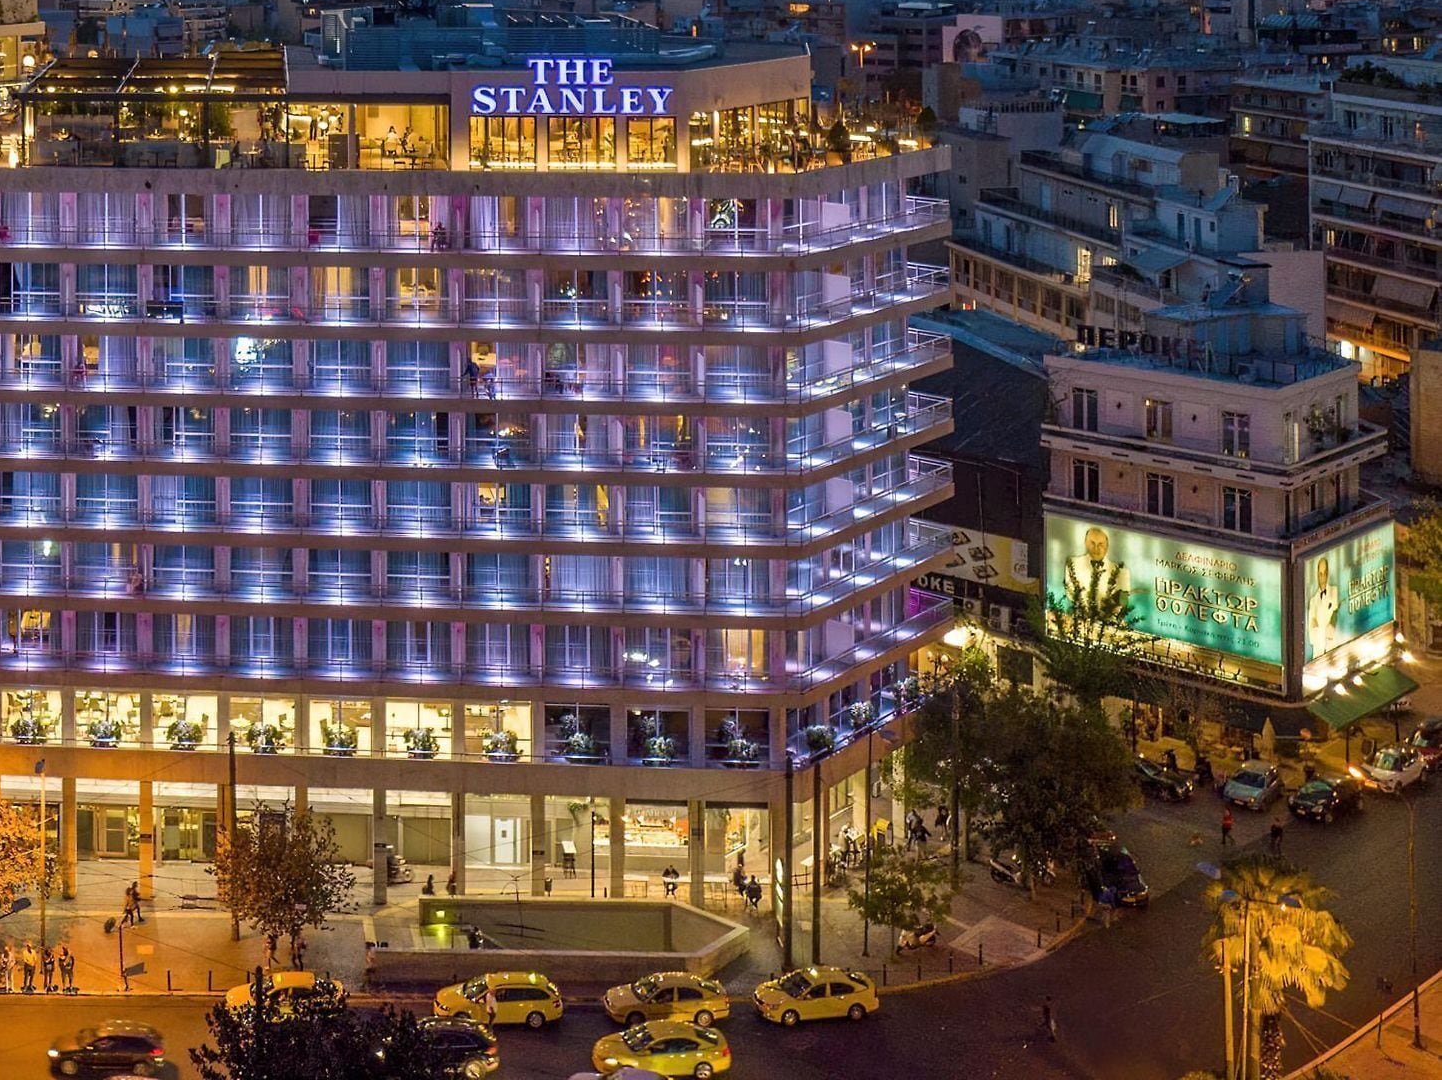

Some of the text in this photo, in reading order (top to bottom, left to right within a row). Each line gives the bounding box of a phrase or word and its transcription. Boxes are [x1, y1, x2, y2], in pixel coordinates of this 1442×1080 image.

[528, 58, 614, 85] THE
[471, 86, 674, 114] STANLEY
[1155, 558, 1197, 575] ΜΑΡΚΟΣ
[1154, 576, 1258, 612] ΠΡΑΚΤΩΡ
